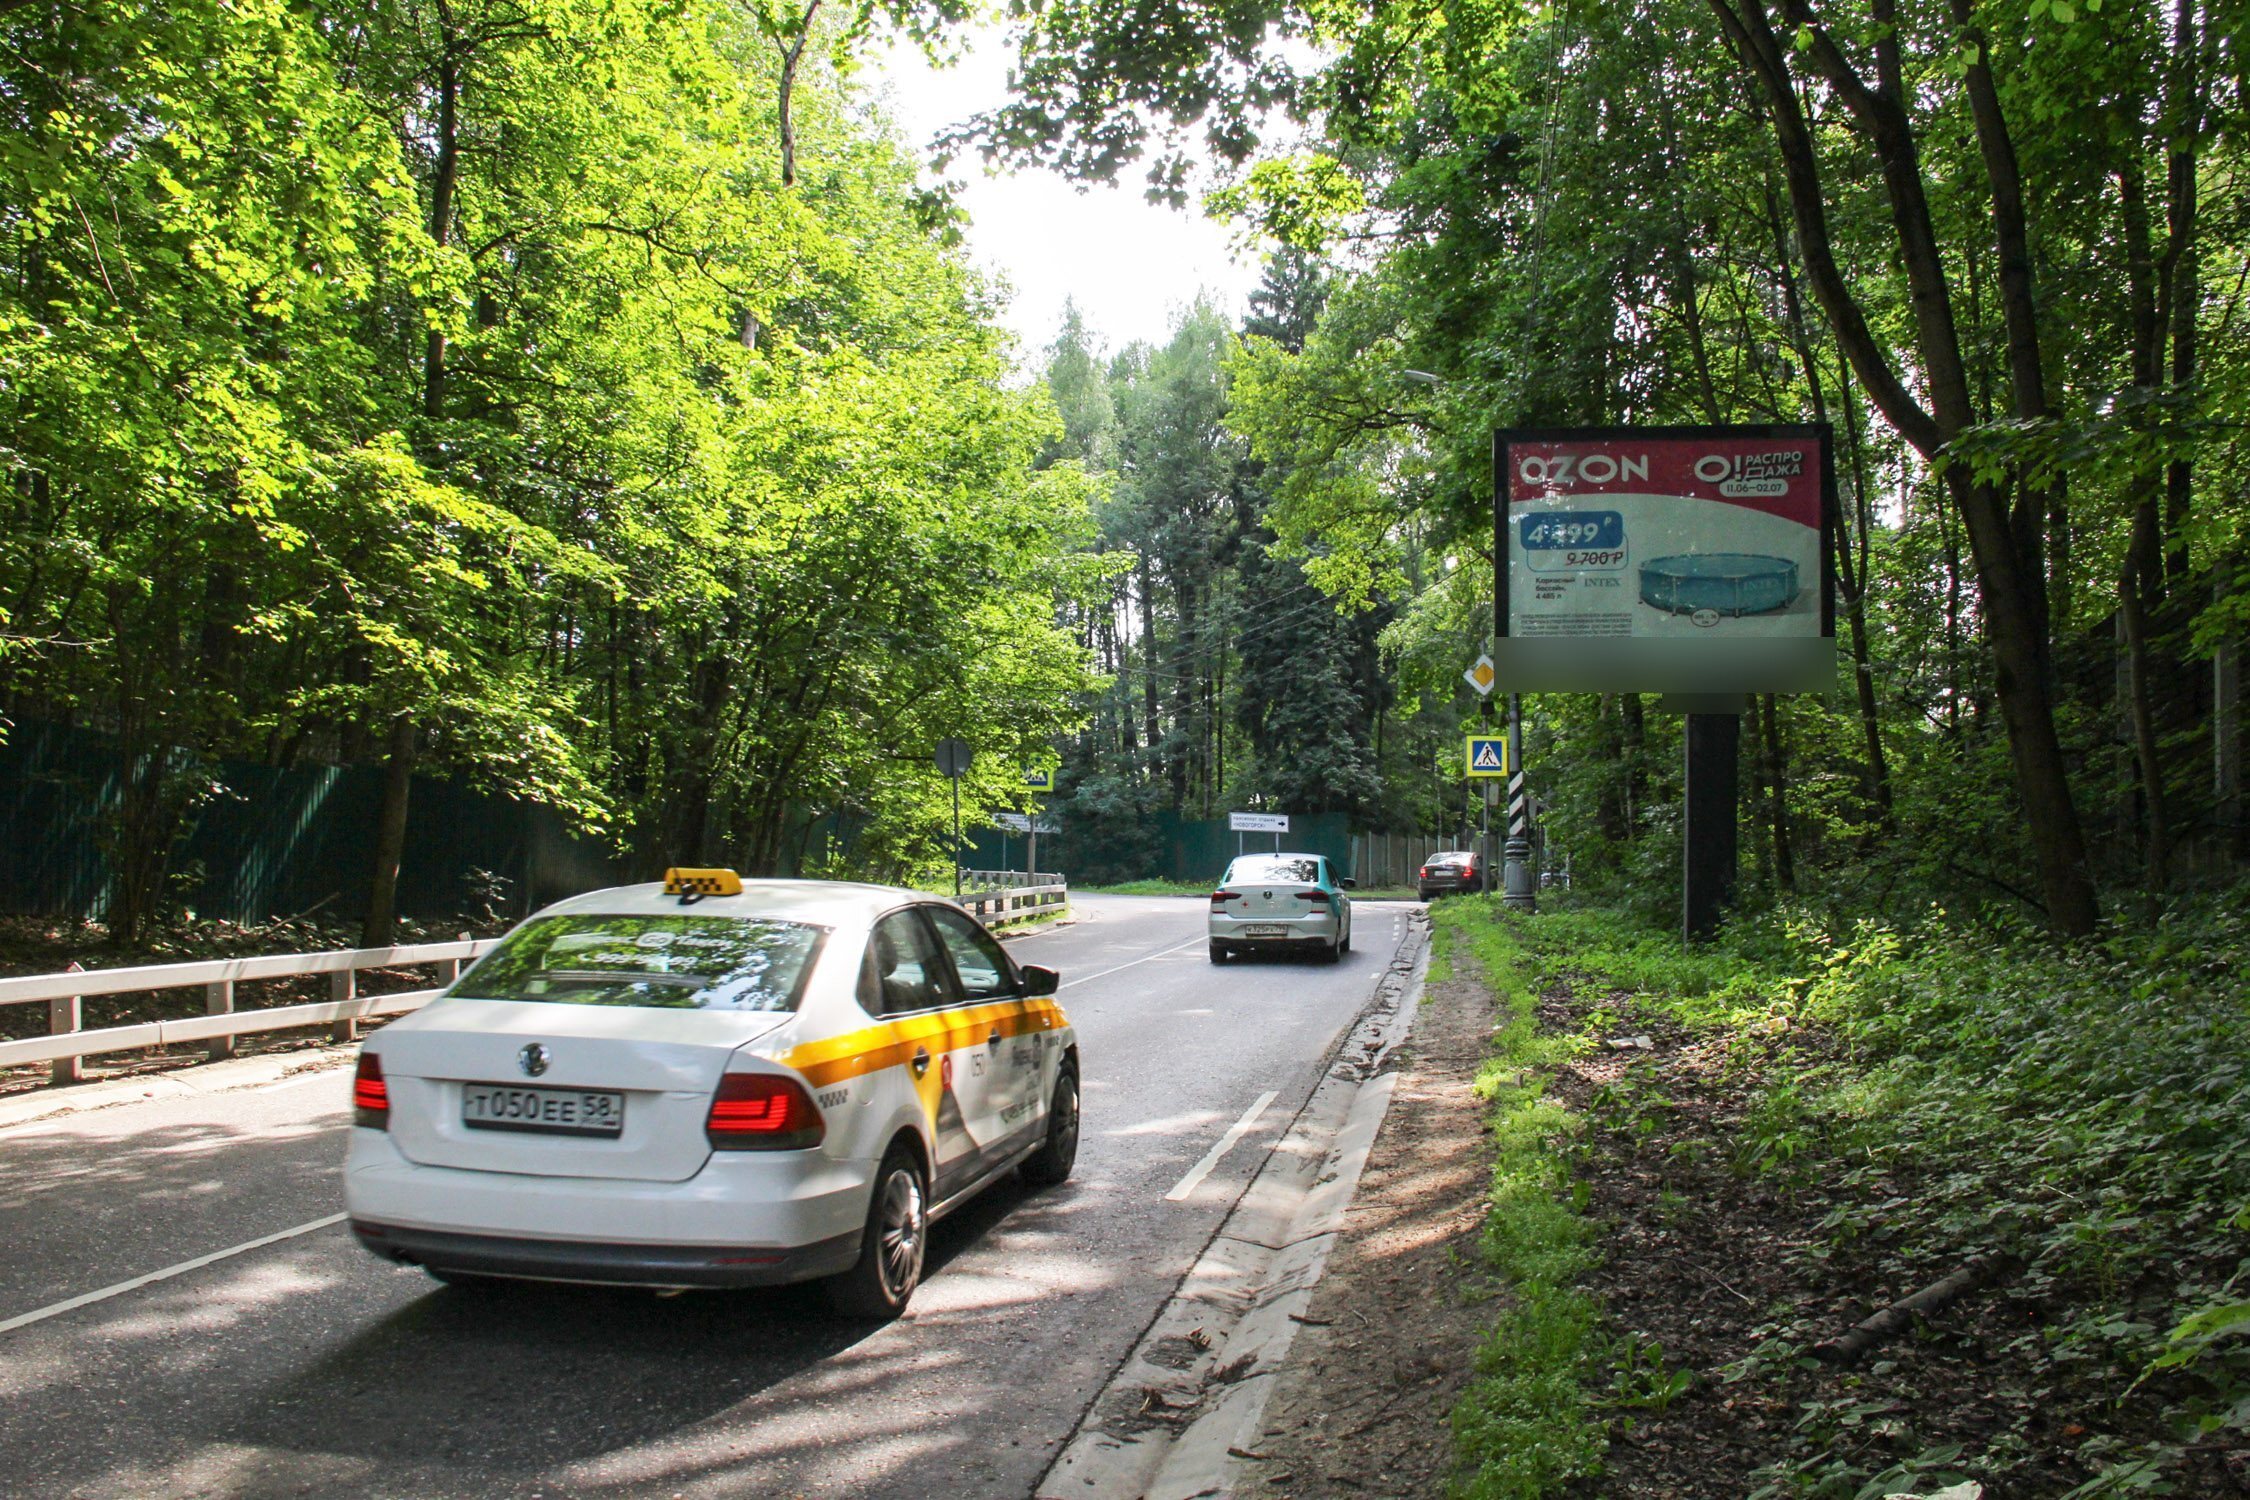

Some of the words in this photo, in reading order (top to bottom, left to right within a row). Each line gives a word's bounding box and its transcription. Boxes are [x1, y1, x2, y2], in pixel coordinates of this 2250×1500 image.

[1745, 451, 1802, 466] РАСПРО
[1520, 454, 1649, 485] OZON
[1744, 464, 1801, 481] ДАЖА
[1584, 577, 1621, 587] INTEX
